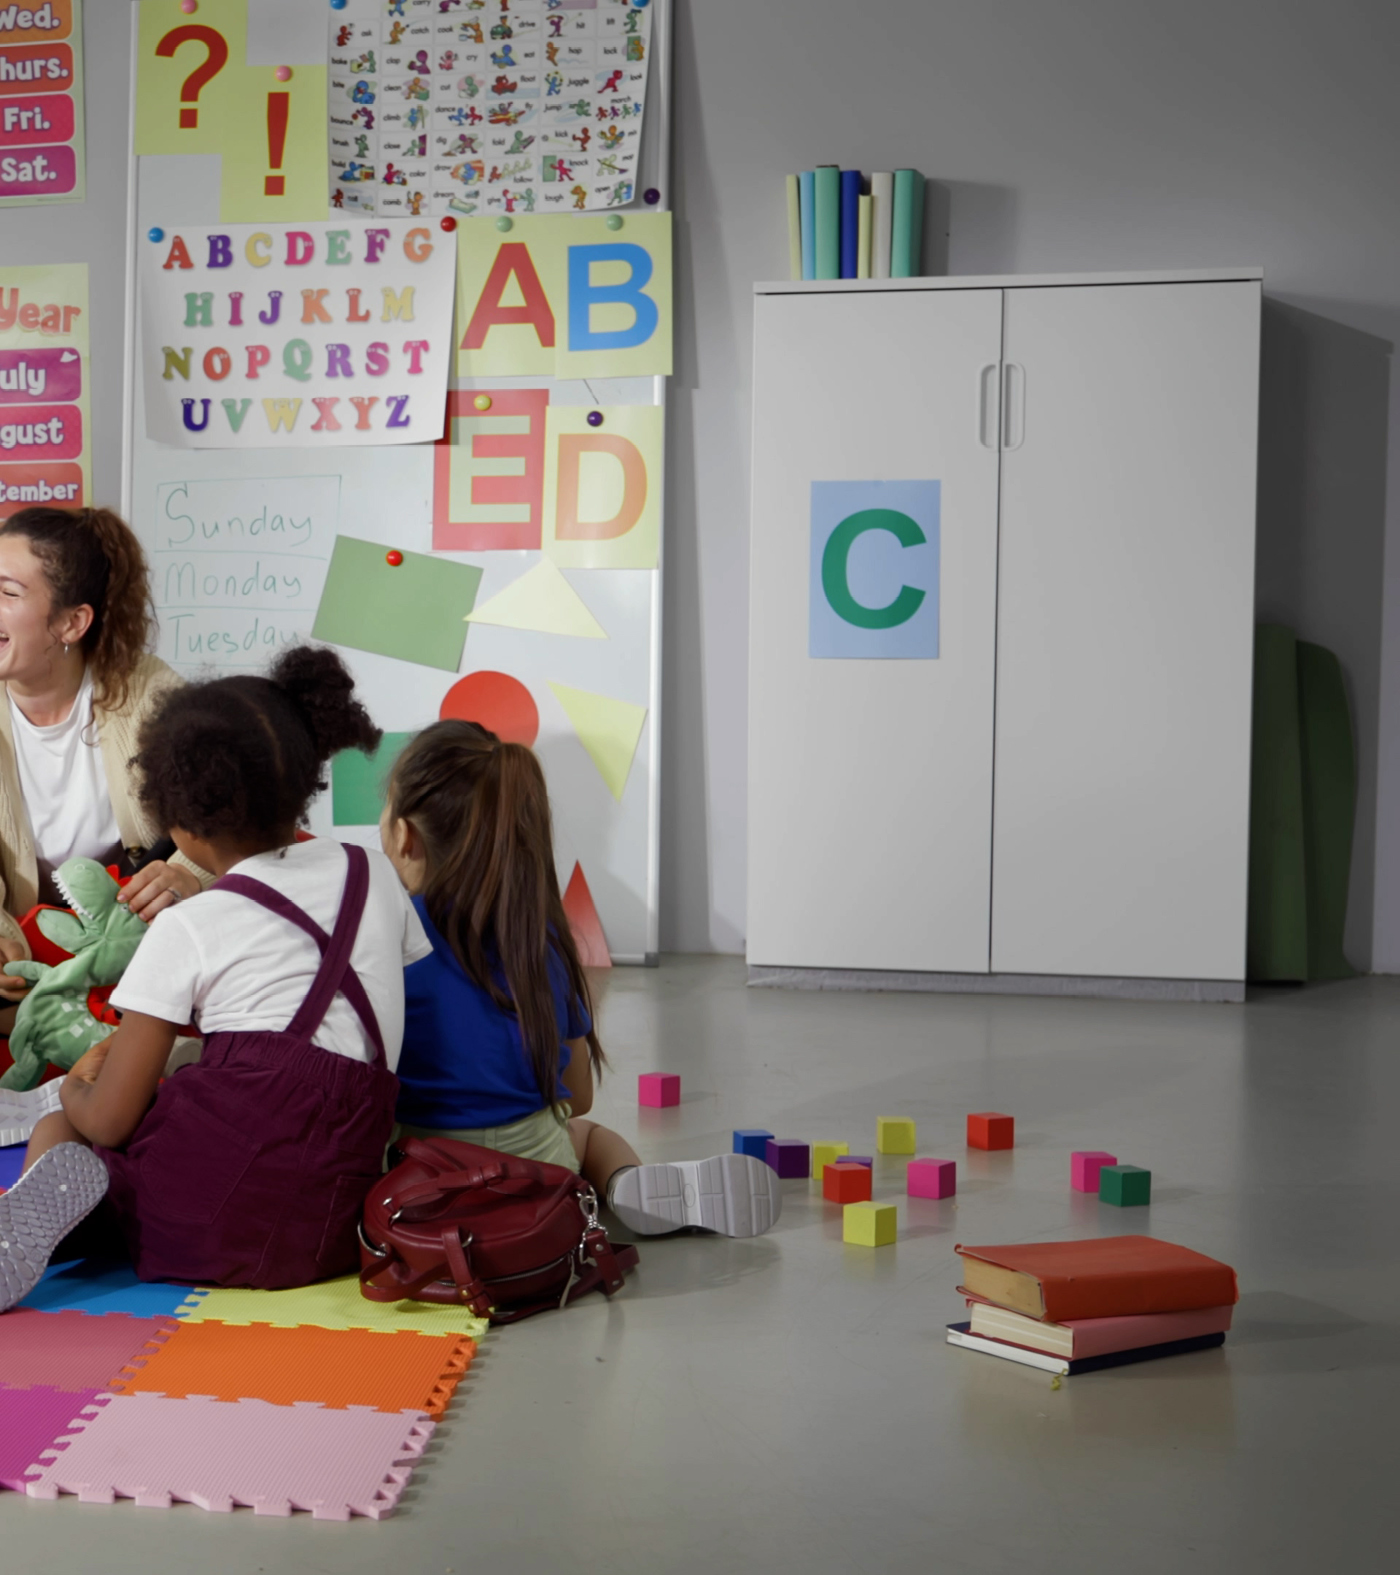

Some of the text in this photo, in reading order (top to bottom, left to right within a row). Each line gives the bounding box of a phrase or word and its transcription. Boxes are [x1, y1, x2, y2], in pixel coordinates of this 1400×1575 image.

[518, 21, 536, 29] drive
[155, 24, 229, 129] ?
[567, 77, 589, 88] juggle
[3, 107, 51, 132] Fri.
[330, 116, 354, 126] bounce
[383, 113, 401, 122] climb
[434, 105, 456, 114] dance
[265, 91, 290, 196] !
[569, 158, 589, 167] knock
[1, 155, 57, 183] Sat.
[409, 170, 427, 178] color
[433, 190, 456, 200] dream
[162, 227, 434, 270] A B C D E F G
[183, 286, 416, 327] H I J K L M
[460, 242, 555, 350] A
[568, 242, 658, 352] B
[161, 338, 429, 381] N O P Q R S T
[181, 394, 411, 433] U V W X Y Z
[448, 415, 530, 523] E
[555, 432, 647, 541] D
[165, 482, 312, 548] Sunday
[165, 561, 301, 604] Monday
[822, 508, 927, 630] C
